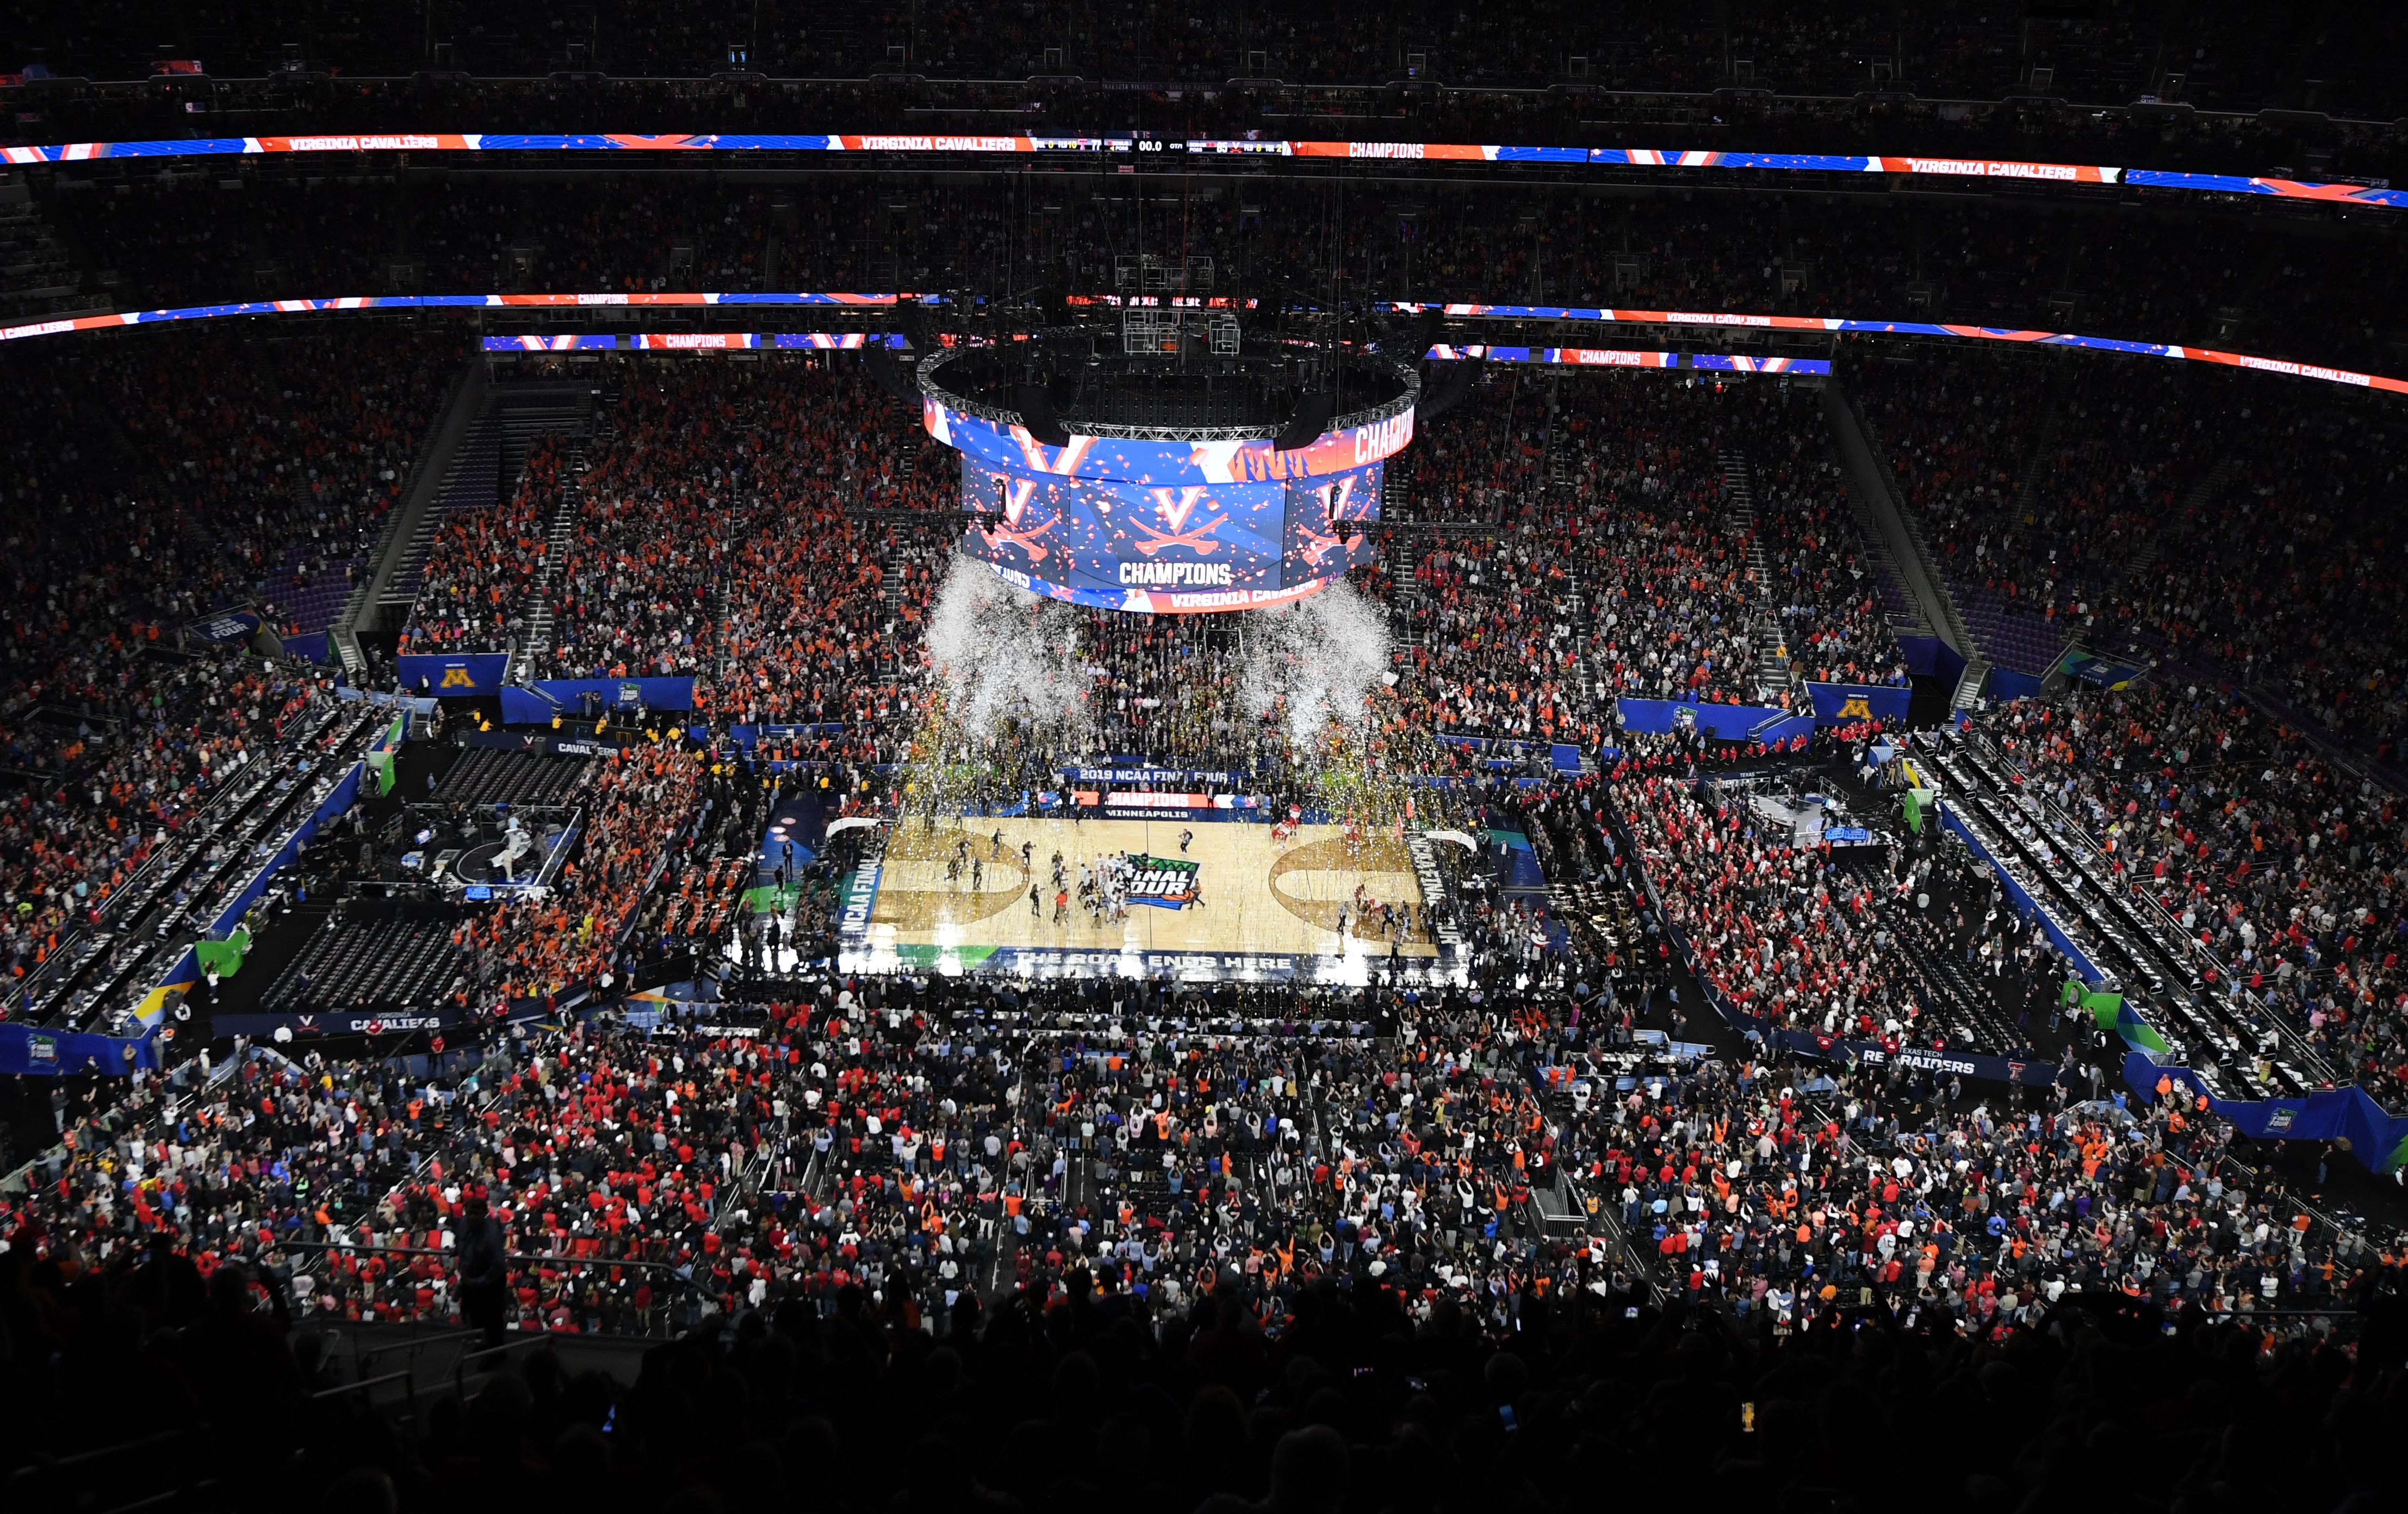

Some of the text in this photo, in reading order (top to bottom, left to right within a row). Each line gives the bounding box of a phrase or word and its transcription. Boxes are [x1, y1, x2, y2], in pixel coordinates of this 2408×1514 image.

[289, 135, 438, 150] VIRGINIA CAVALIERS
[861, 137, 1016, 151] VIRGINIA CAVALIERS
[1091, 140, 1102, 151] 77
[1139, 140, 1162, 152] 00.0
[1349, 141, 1425, 159] CHAMPIONS
[1911, 159, 2077, 180] VIRGINIA CAVALIERS
[578, 294, 629, 305] CHAMPIONS
[1667, 313, 1771, 326] VIRGINIA CAVALIERS
[7, 320, 75, 338] CAVALIERS
[666, 334, 726, 348] CHAMPIONS
[1579, 350, 1641, 365] CHAMPIONS
[2240, 357, 2370, 386] VIRGINIA CAVALIERS
[1119, 562, 1231, 585] CHAMPIONS
[1171, 579, 1318, 607] VIRGINIA CAVALIERS
[211, 623, 250, 638] FOUR
[558, 743, 619, 756] CAVALERS
[1080, 770, 1113, 780] 2019
[1116, 770, 1150, 781] NCAA
[1104, 792, 1189, 807] CHAMPIONS
[1106, 810, 1188, 818] MINNEAPOLIS
[1133, 870, 1190, 883] INAL
[1130, 882, 1187, 895] OUR
[841, 895, 871, 931] NCAA
[1013, 951, 1062, 965] THE
[1070, 953, 1121, 966] ROA
[1225, 957, 1292, 969] HERE
[1899, 1047, 1943, 1059] TEXAS TECH
[1863, 1050, 1976, 1075] RE RAIDERS
